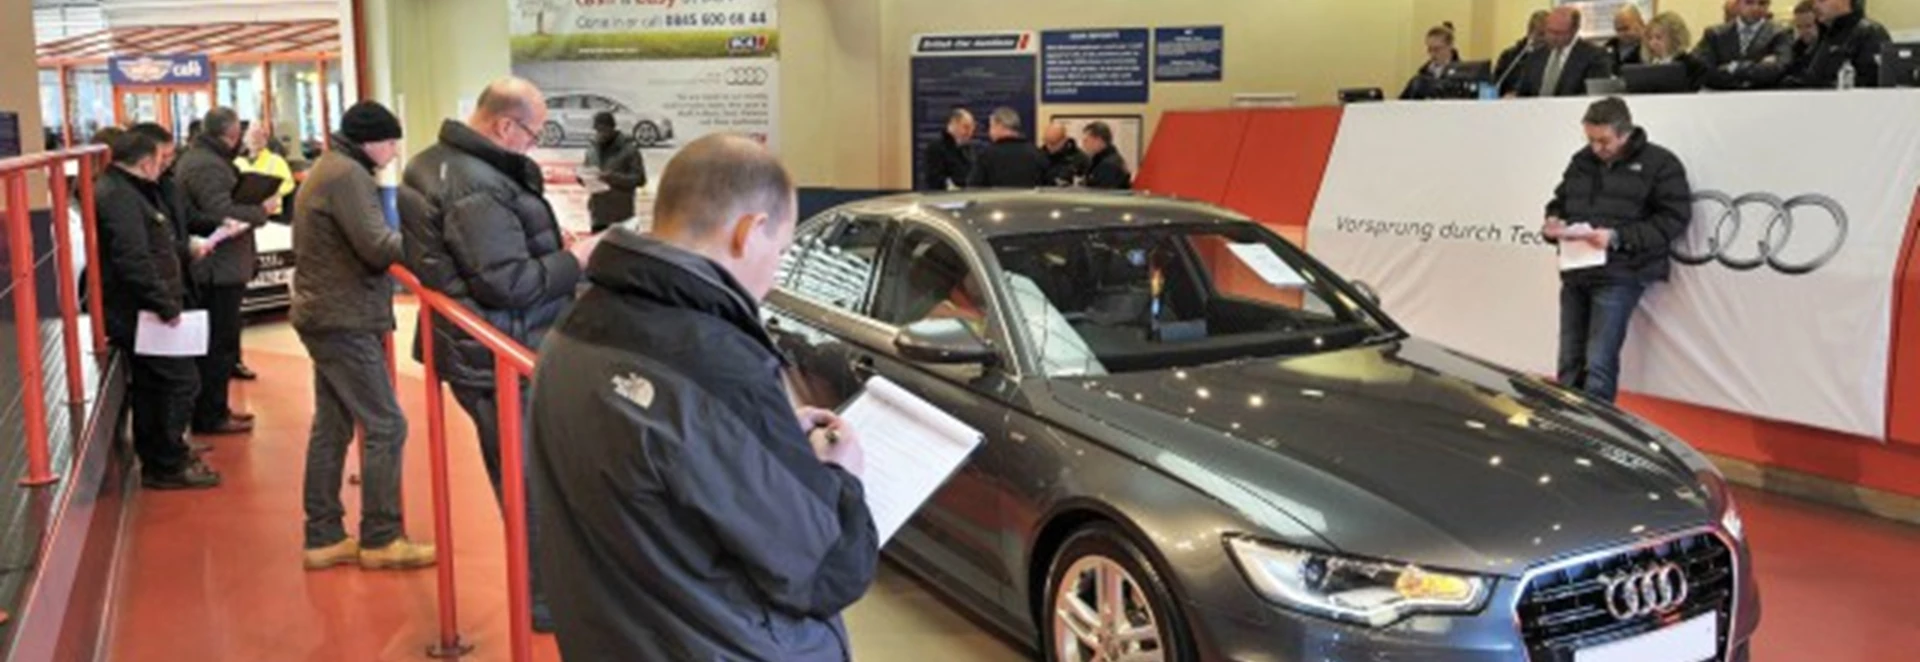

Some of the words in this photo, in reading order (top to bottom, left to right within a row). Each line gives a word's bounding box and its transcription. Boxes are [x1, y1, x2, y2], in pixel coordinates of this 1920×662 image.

[1336, 216, 1434, 242] Vorsprung
[1439, 221, 1501, 241] durch
[1508, 224, 1546, 245] Tec
